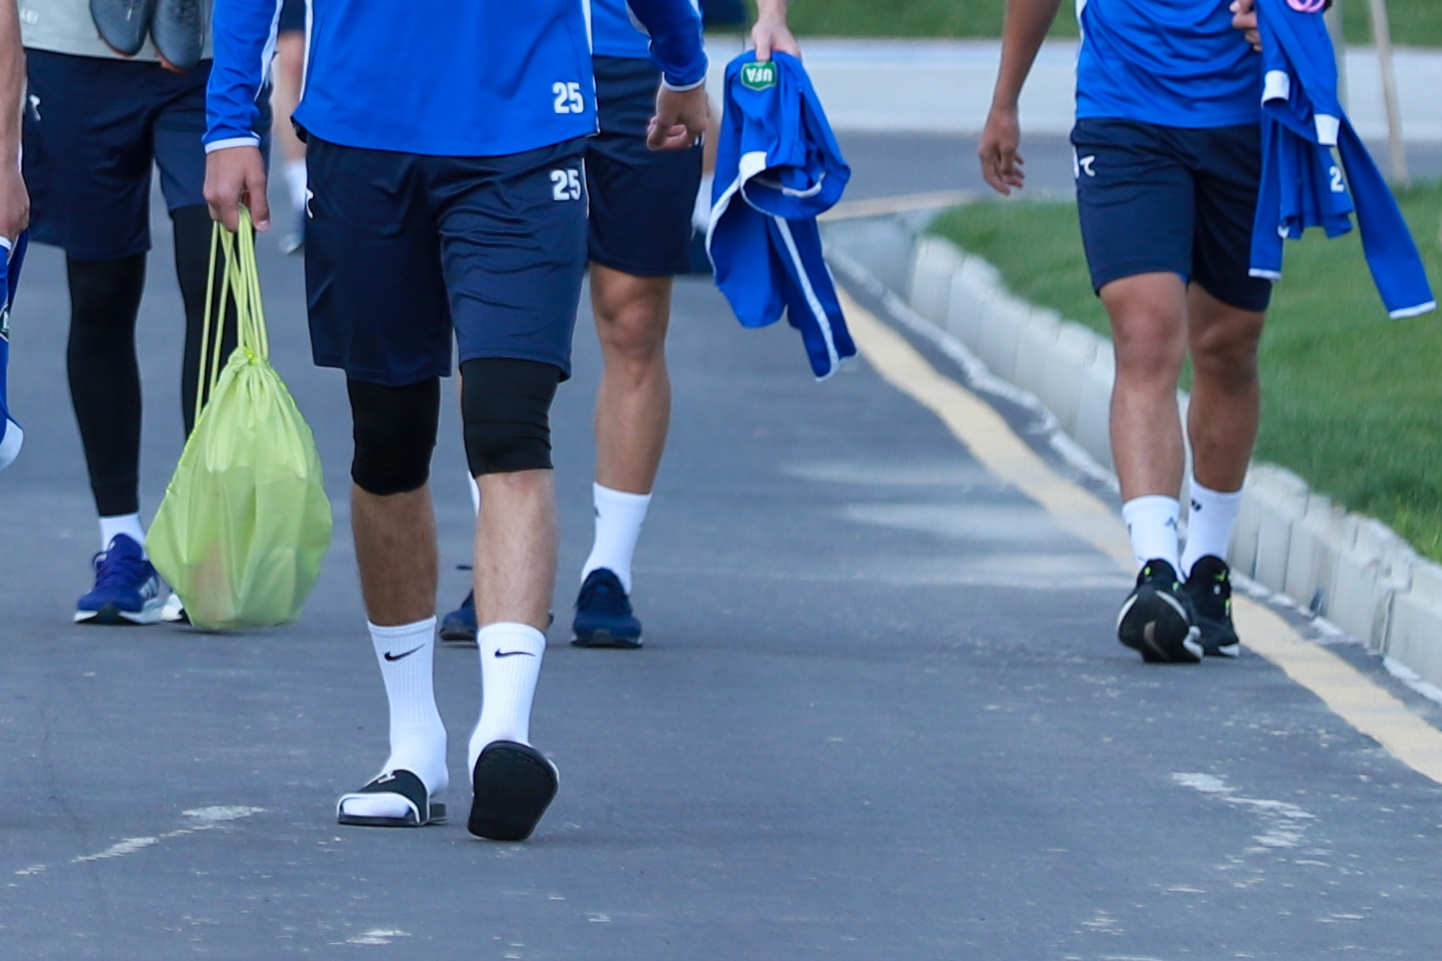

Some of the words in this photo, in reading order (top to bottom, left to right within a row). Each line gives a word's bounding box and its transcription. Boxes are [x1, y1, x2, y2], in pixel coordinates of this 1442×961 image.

[746, 67, 773, 83] UFA
[552, 82, 584, 113] 25
[550, 169, 581, 201] 25
